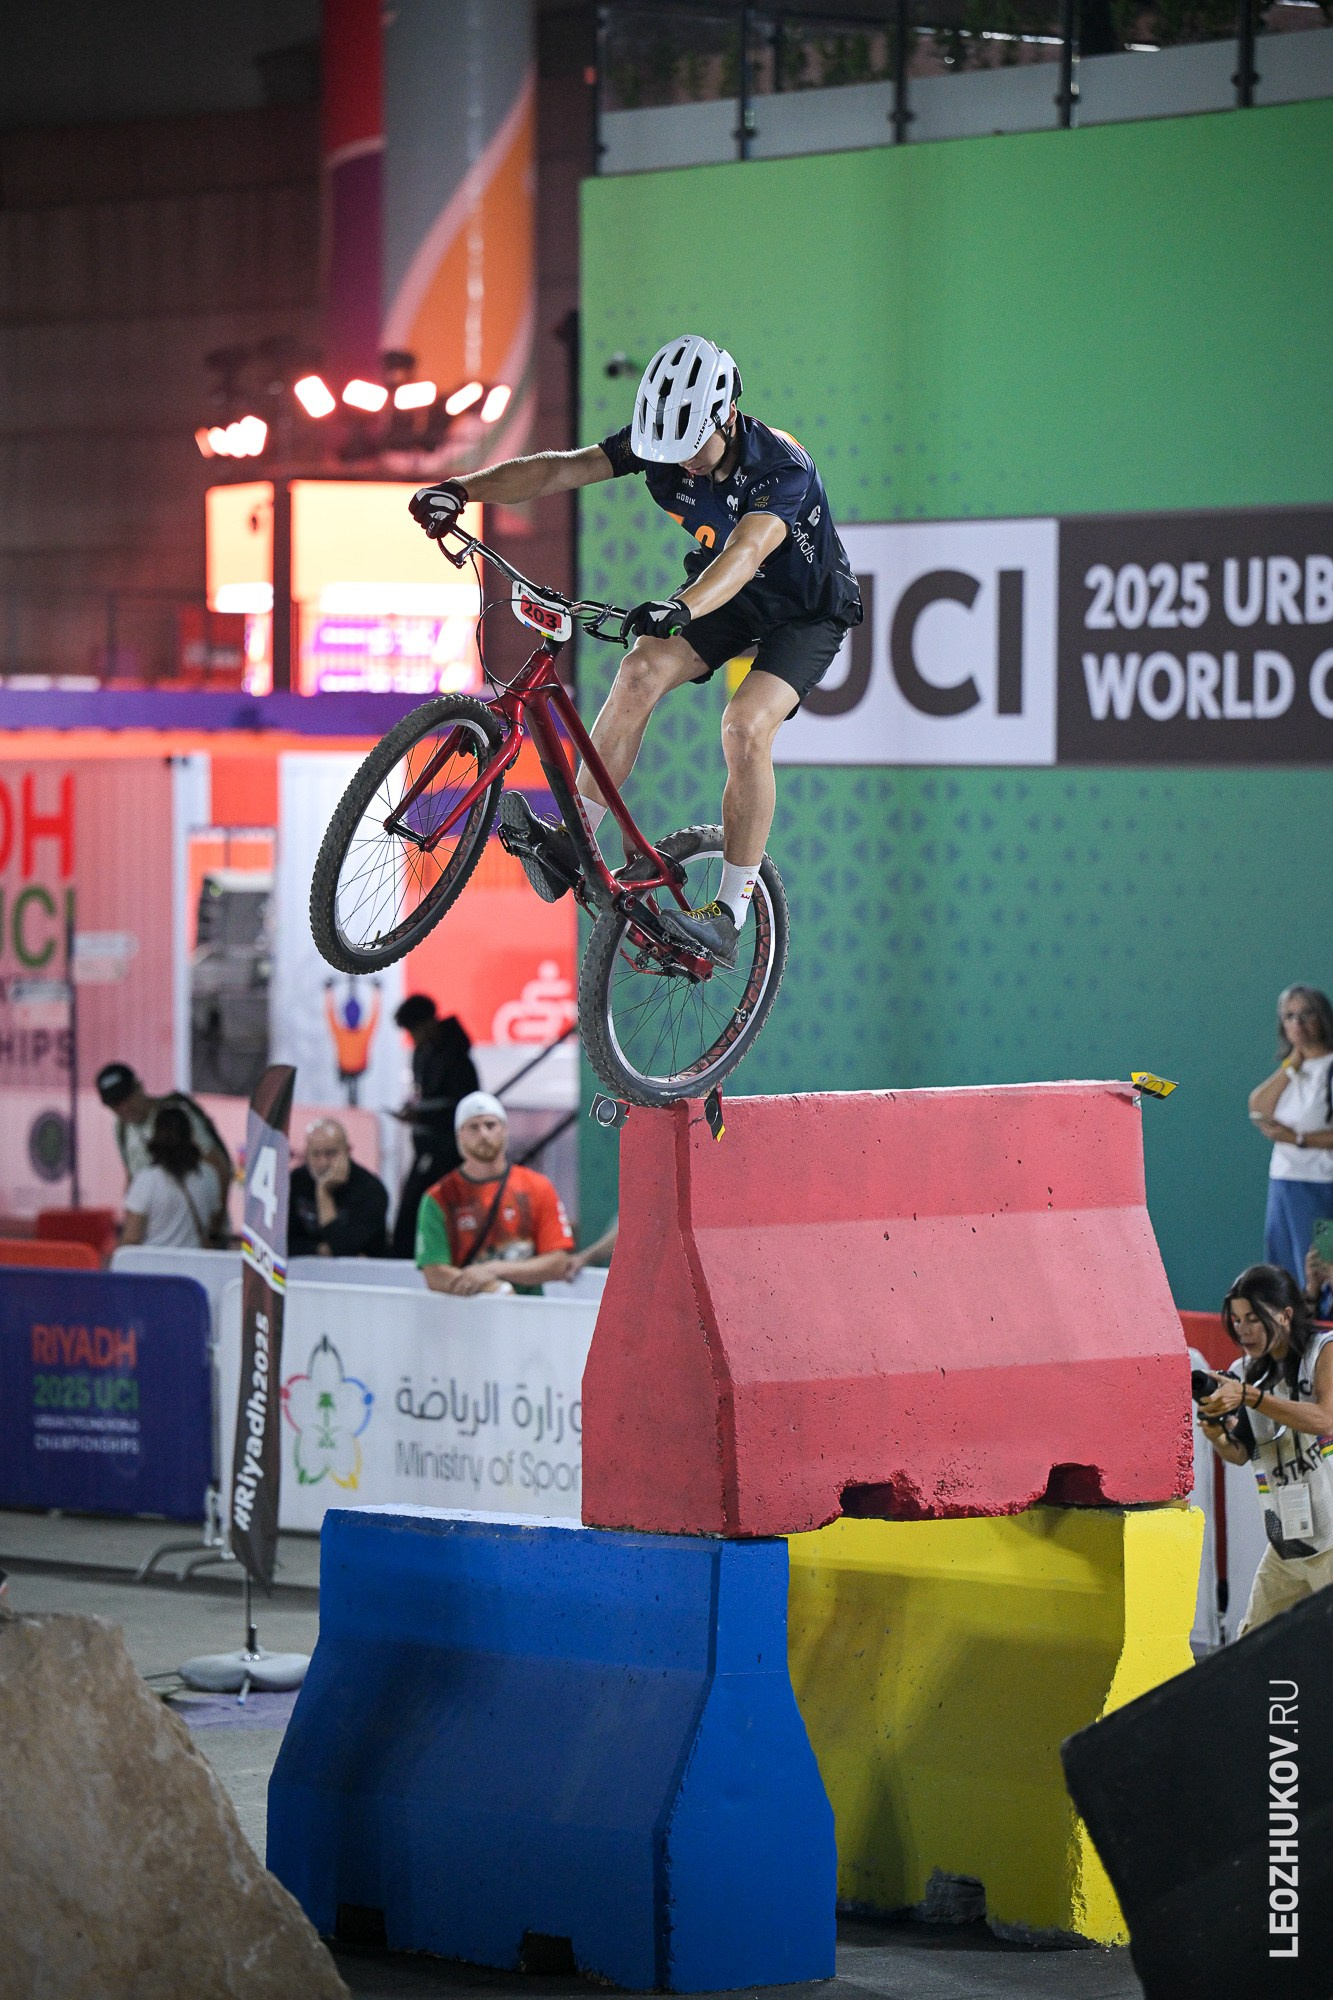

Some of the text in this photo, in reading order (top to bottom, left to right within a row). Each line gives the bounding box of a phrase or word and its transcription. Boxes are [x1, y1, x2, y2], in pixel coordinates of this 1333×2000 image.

[676, 492, 696, 506] GOBIK
[792, 522, 815, 564] Cofidis
[524, 600, 557, 629] 203
[1084, 554, 1333, 630] 2025 URB
[1082, 649, 1296, 721] WORLD
[250, 1145, 279, 1230] 4
[31, 1324, 138, 1369] RIYADH
[33, 1374, 139, 1411] 2025 UCI
[234, 1312, 270, 1531] #Riyadh2025
[394, 1439, 483, 1492] Ministry
[487, 1449, 516, 1487] of
